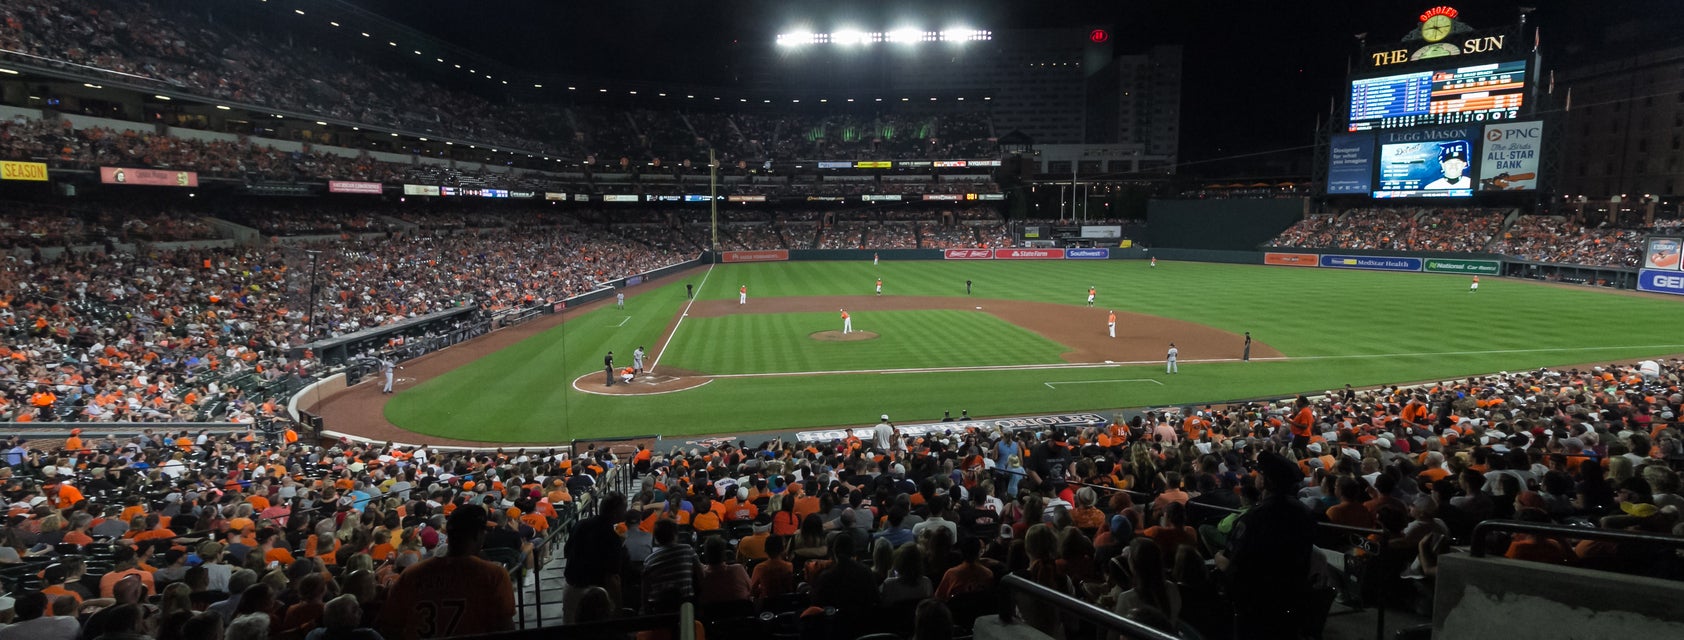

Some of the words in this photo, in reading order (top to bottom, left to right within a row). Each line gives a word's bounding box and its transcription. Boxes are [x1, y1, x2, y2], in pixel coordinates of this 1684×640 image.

[1372, 49, 1408, 67] THE
[1463, 35, 1505, 54] SUN
[1476, 113, 1484, 121] 0
[1492, 112, 1501, 120] 0
[1508, 111, 1517, 119] 2
[1390, 132, 1420, 143] LEGG
[1423, 129, 1468, 141] MASON
[1505, 127, 1539, 140] PNC
[1487, 150, 1534, 161] ALL-STAR
[4, 162, 44, 178] SEASON
[1496, 160, 1522, 170] BANK
[1436, 262, 1465, 270] National
[1653, 275, 1684, 289] GEI
[994, 413, 1099, 428] ORIOLES
[1357, 537, 1371, 552] 26
[415, 598, 467, 640] 37
